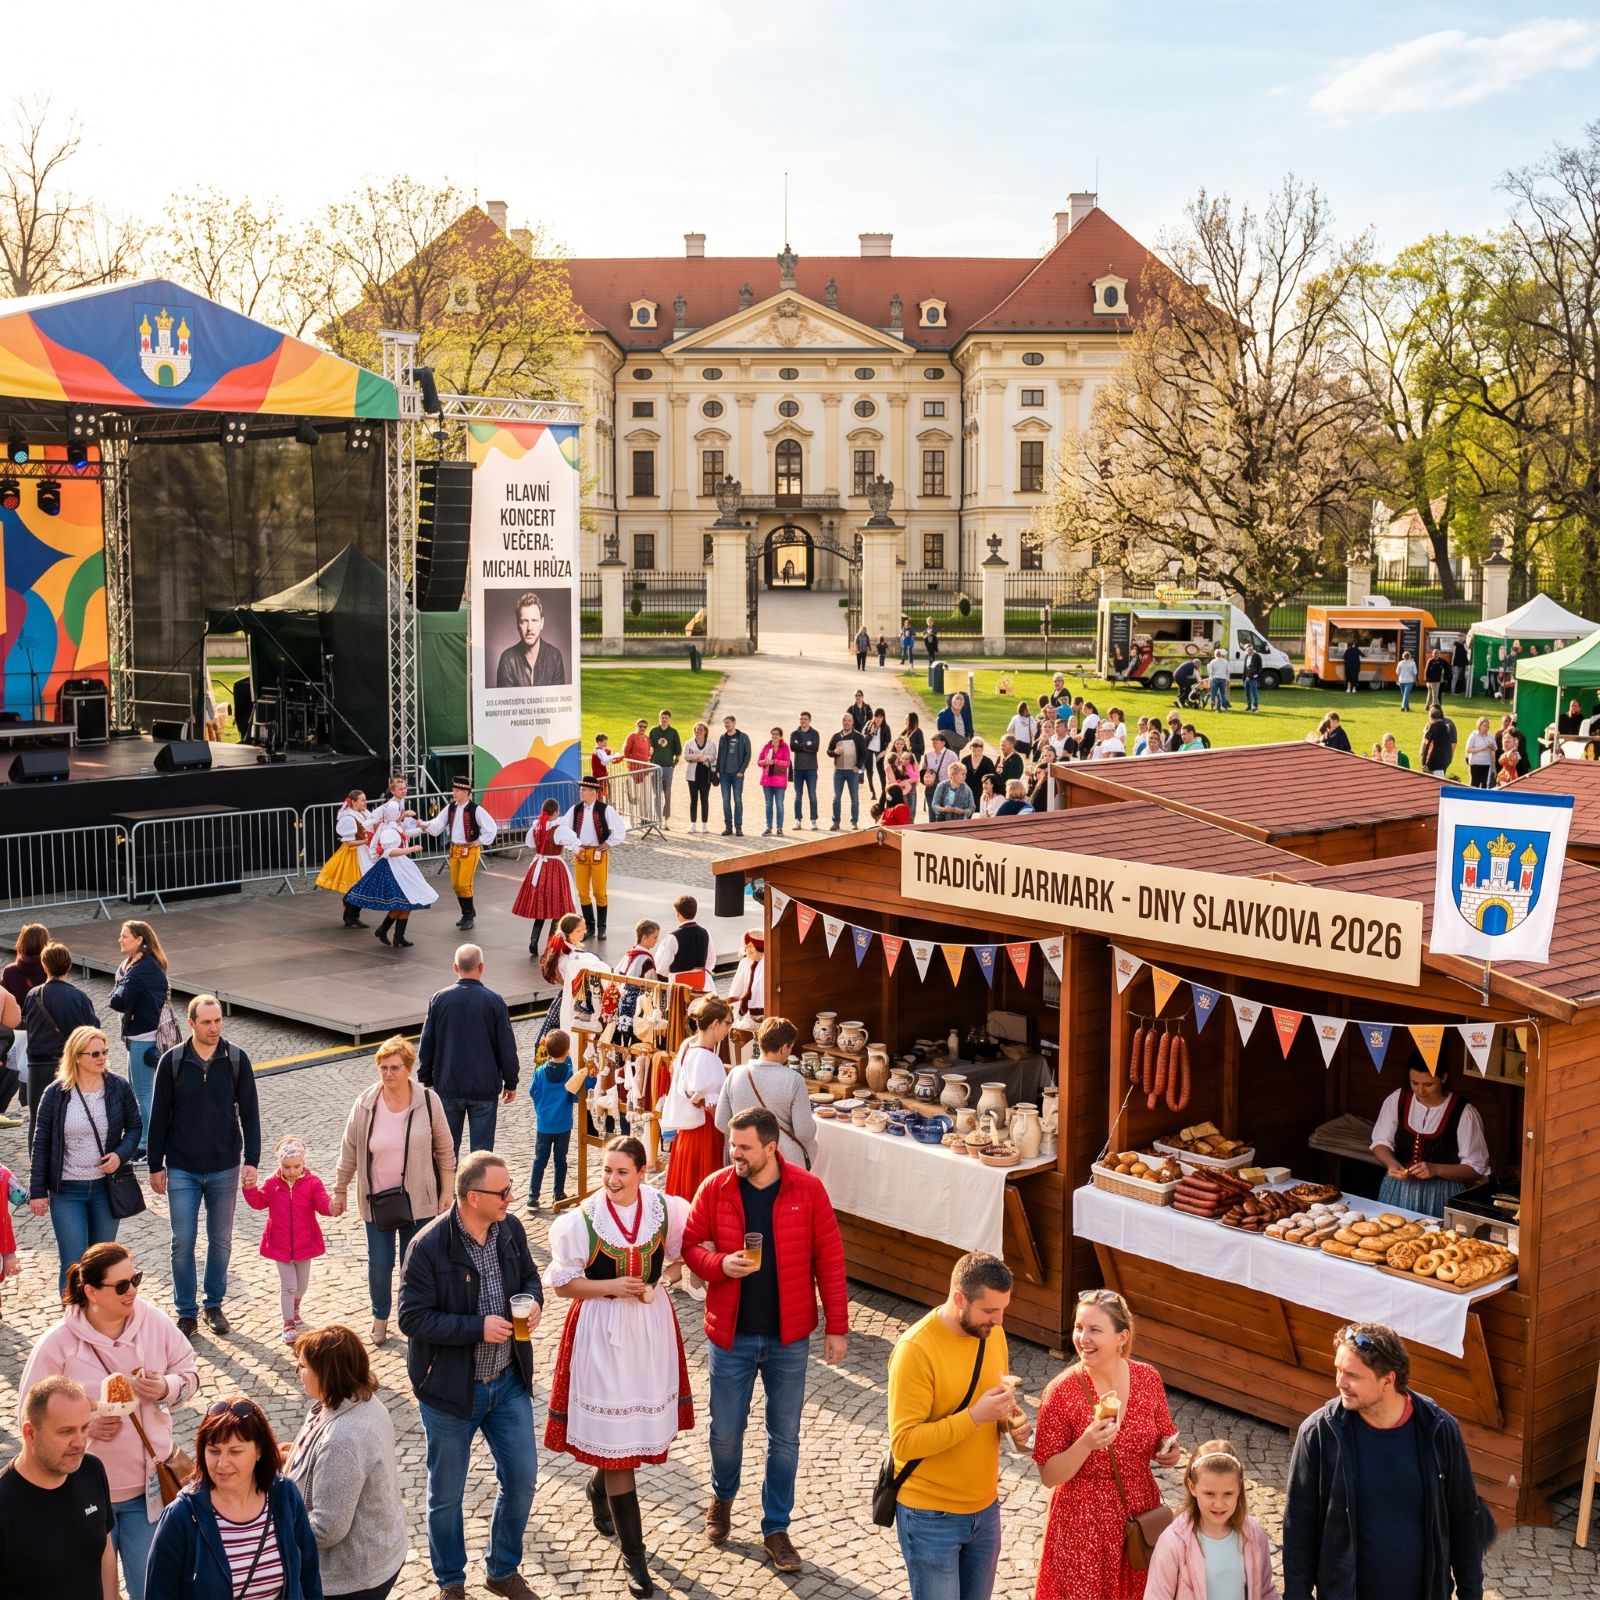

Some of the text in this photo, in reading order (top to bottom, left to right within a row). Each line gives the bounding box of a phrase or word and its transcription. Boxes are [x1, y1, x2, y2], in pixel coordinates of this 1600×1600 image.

[506, 480, 550, 502] HLAVNÍ
[500, 508, 556, 526] KONCERT
[503, 529, 553, 550] VEČERA:
[482, 555, 572, 578] MICHAL HRŮZA
[913, 851, 1008, 896] TRADIČNÍ
[1011, 866, 1115, 914] JARMARK
[1138, 885, 1186, 924] DNY
[1192, 893, 1322, 948] SLAVKOVA
[1330, 914, 1403, 960] 2026
